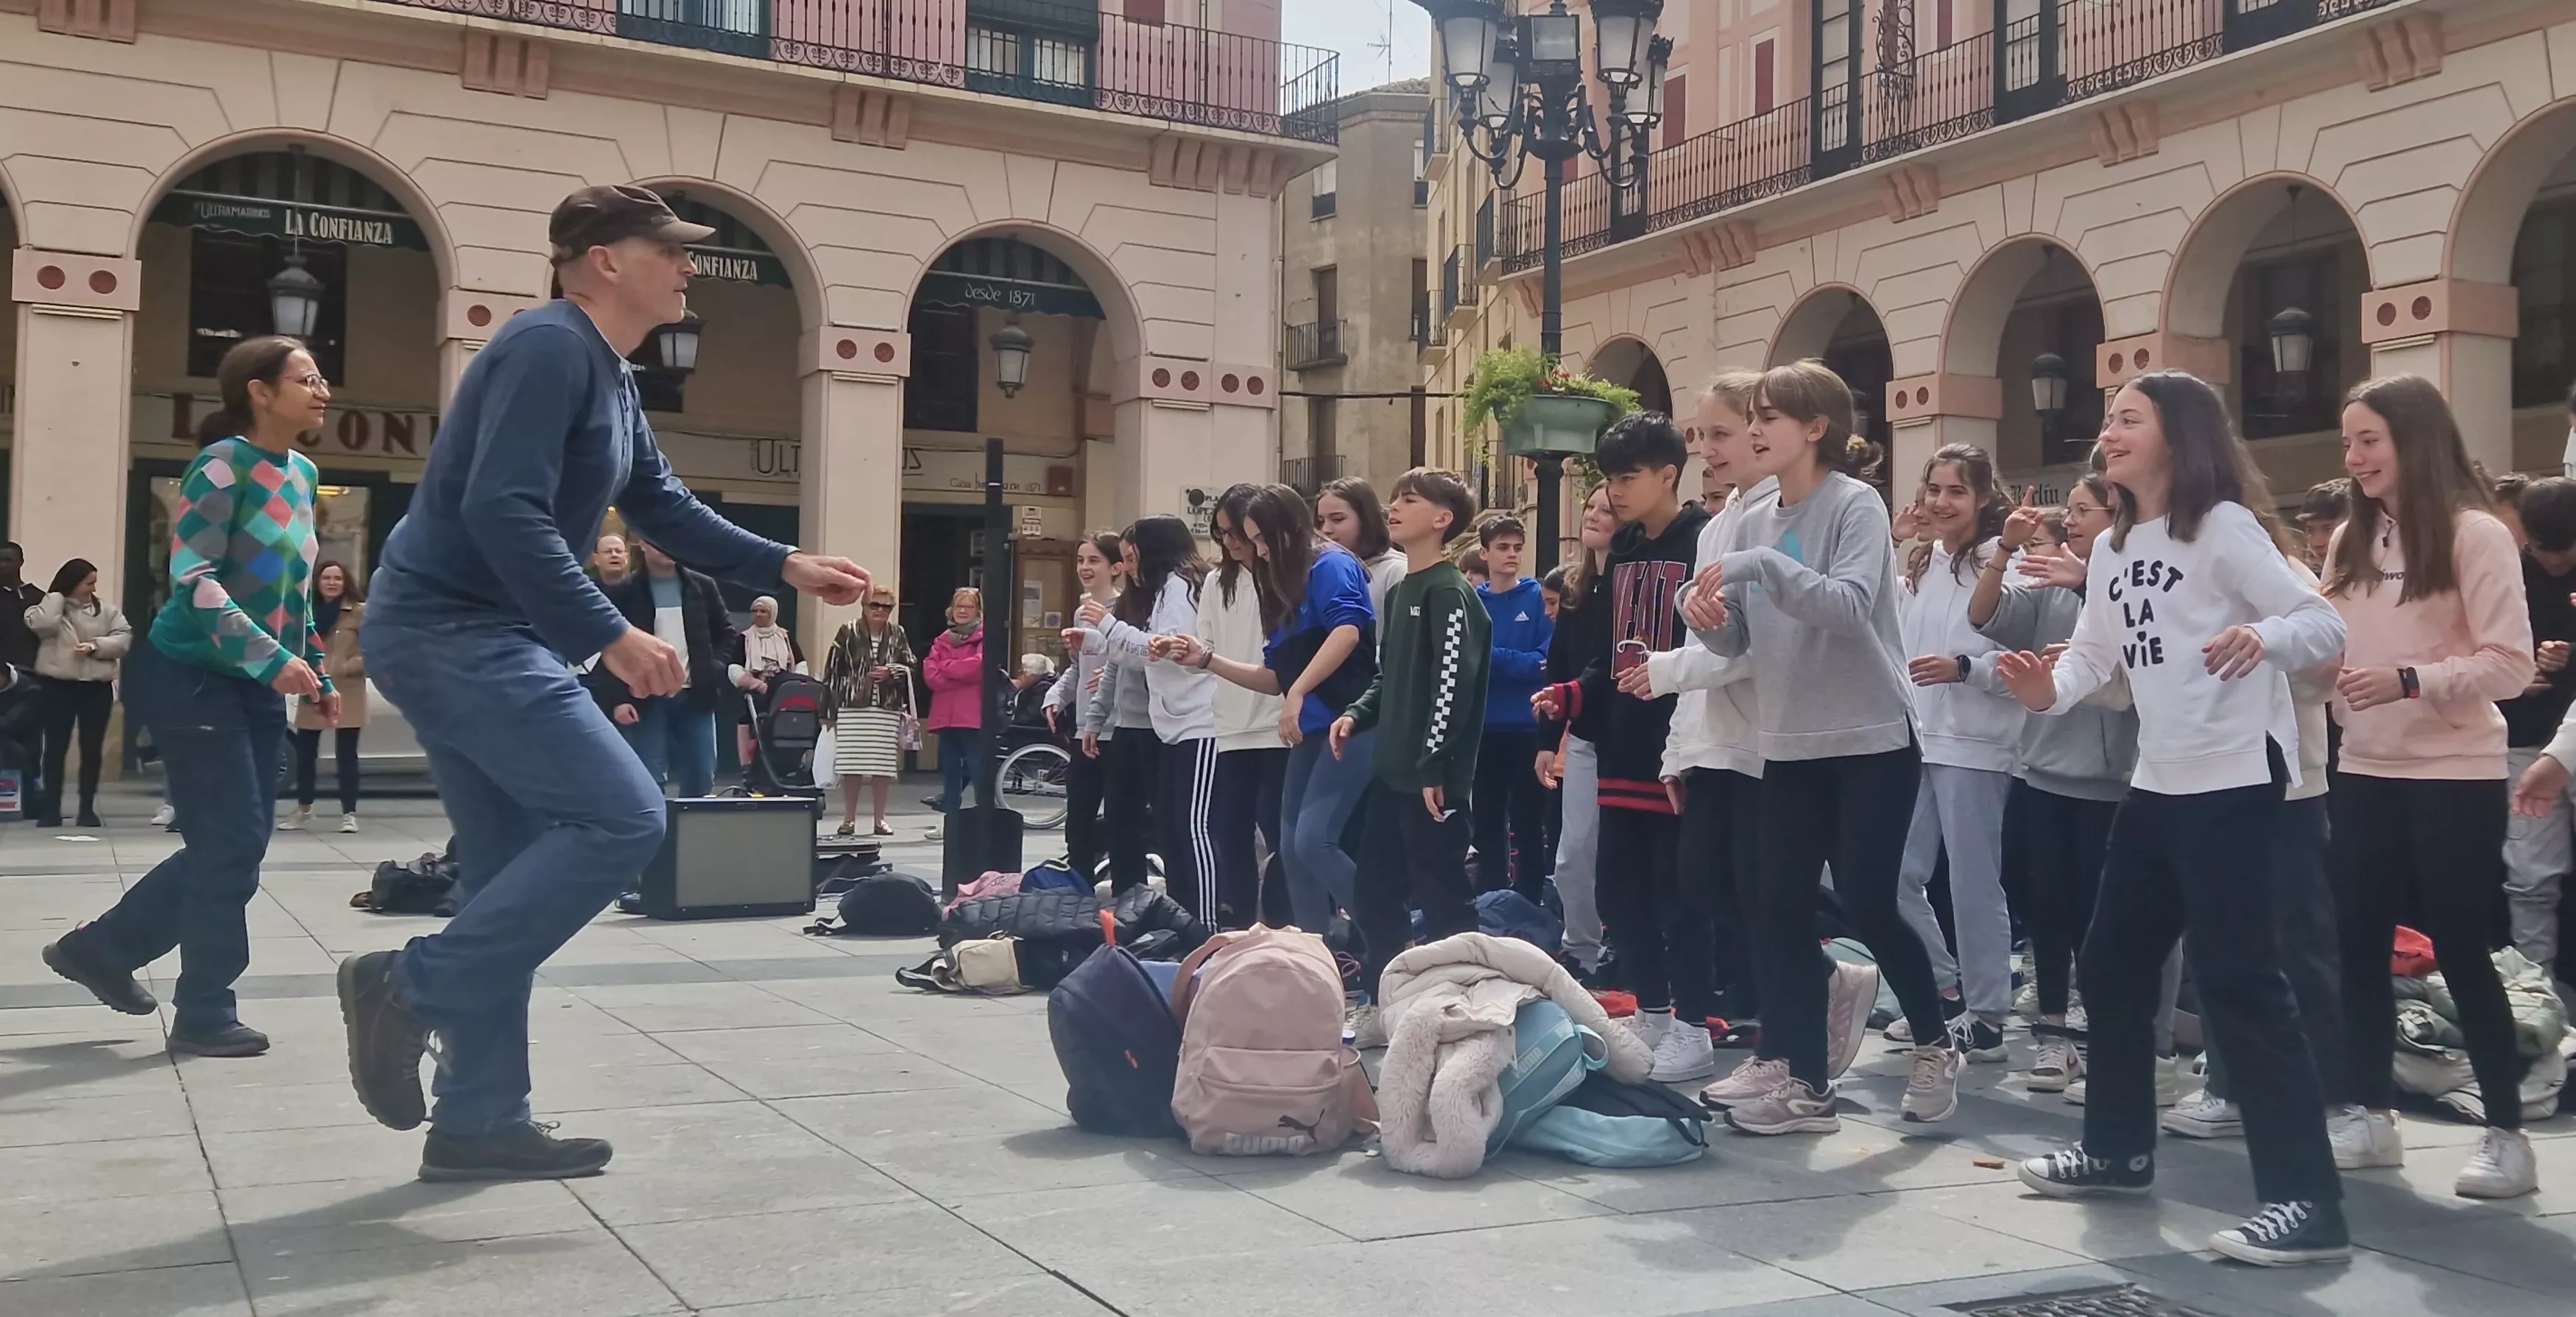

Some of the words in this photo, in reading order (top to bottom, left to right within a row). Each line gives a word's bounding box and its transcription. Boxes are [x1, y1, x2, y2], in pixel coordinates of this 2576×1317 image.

[285, 209, 303, 236] LA
[309, 212, 392, 244] CONFIANZA
[965, 283, 1001, 301] desde
[1009, 290, 1034, 307] 1871
[2109, 560, 2184, 602] C'EST
[2123, 598, 2154, 628] LA
